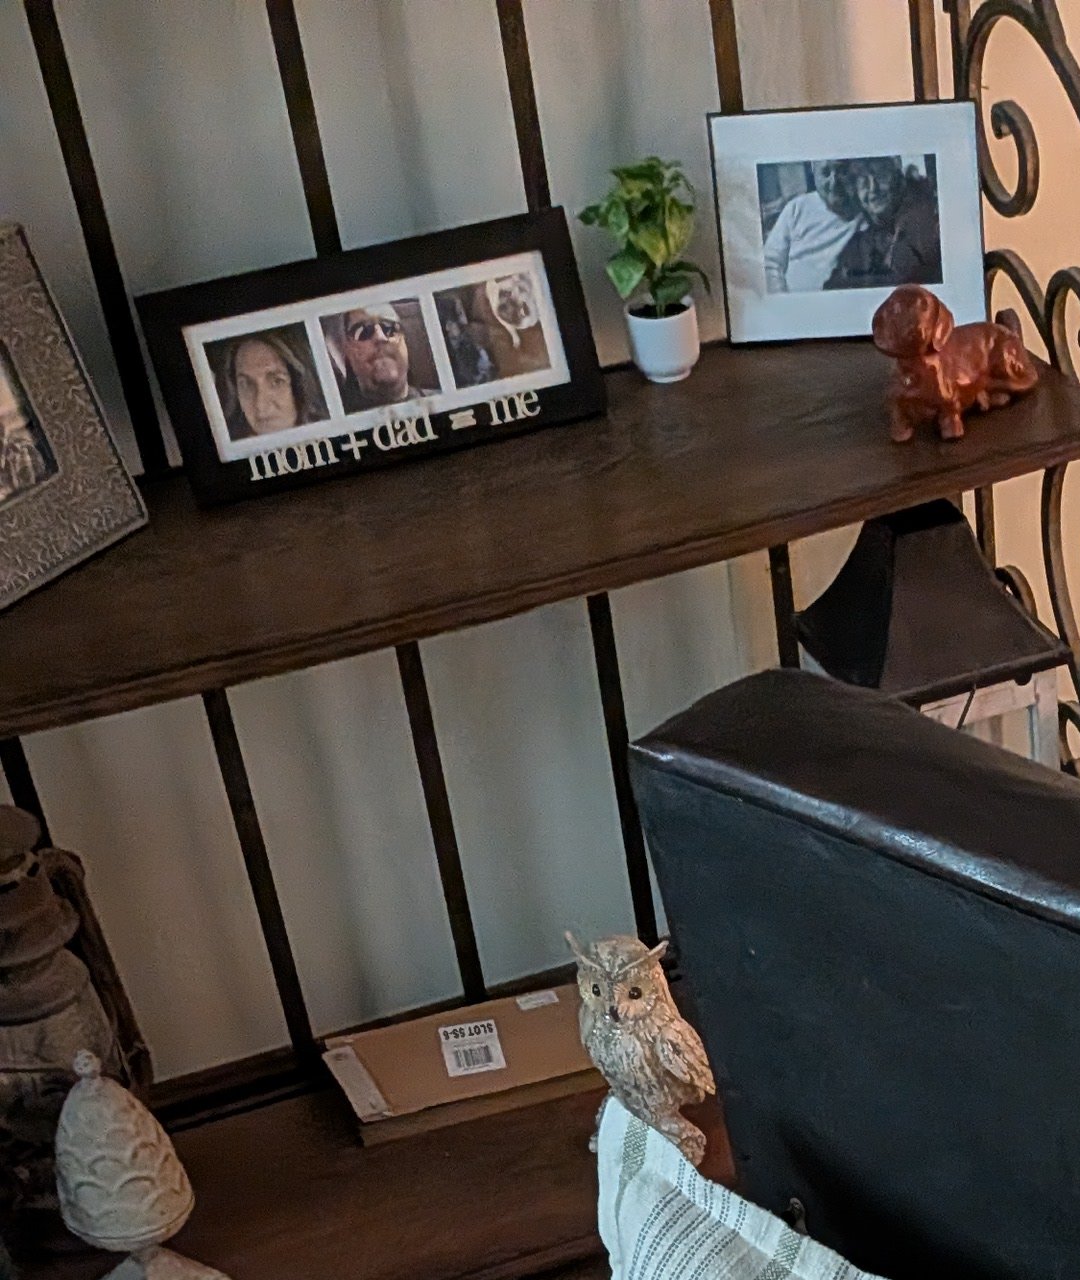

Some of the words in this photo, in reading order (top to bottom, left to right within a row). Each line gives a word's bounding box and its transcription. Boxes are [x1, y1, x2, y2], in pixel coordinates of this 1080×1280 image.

[249, 437, 341, 481] mom
[373, 404, 438, 451] dad
[488, 390, 541, 426] me
[467, 1023, 494, 1037] SLOT
